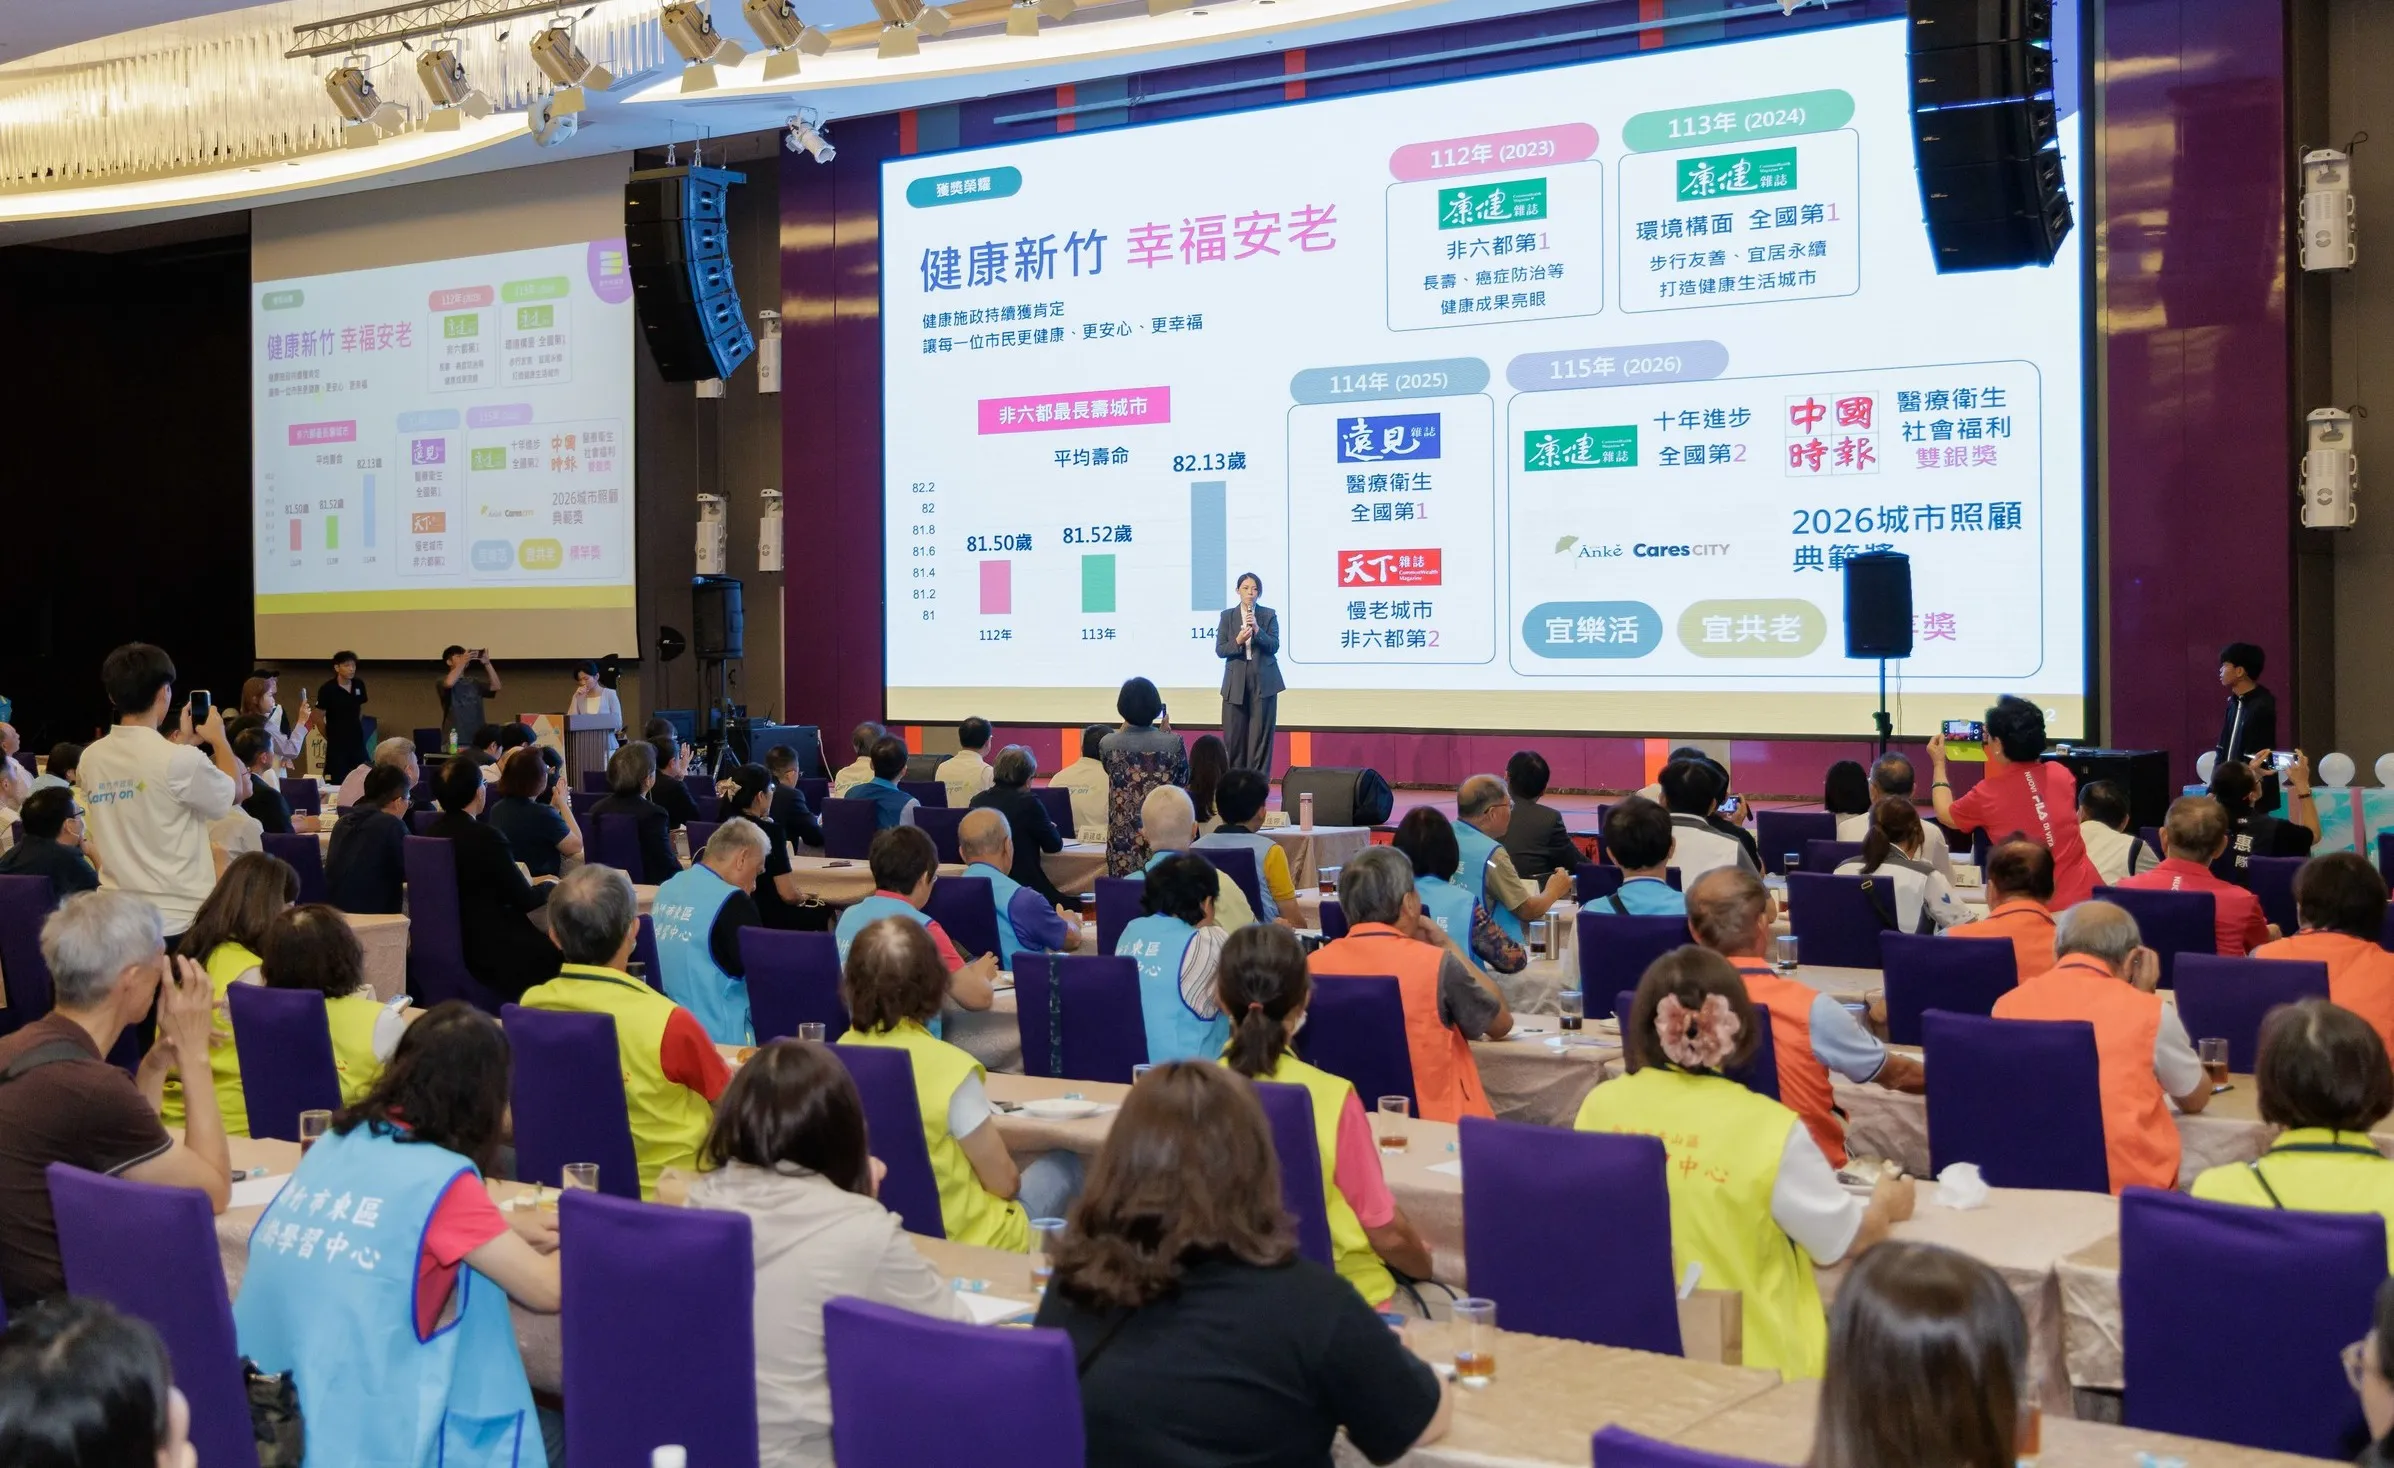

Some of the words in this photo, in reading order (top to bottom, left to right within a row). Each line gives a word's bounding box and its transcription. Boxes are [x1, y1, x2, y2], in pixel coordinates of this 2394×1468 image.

[1667, 111, 1738, 139] 113年
[1744, 107, 1806, 132] (2024)
[1430, 143, 1493, 170] 112年
[1500, 139, 1555, 163] (2023)
[936, 176, 991, 197] 獲獎榮耀
[1681, 157, 1758, 196] 康健
[1443, 188, 1512, 225] 康健
[1635, 211, 1733, 242] 環境構面
[1748, 201, 1841, 231] 全國第1
[919, 228, 1108, 293] 健康新竹
[1126, 202, 1338, 269] 幸福安老
[1446, 231, 1550, 261] 非六都第1
[1649, 239, 1828, 271] 步行友善、宜居永續
[1423, 263, 1564, 291] 長壽、癌症防治等
[1659, 269, 1816, 298] 打造健康生活城市
[922, 301, 1065, 329] 健康施政持續獲肯定
[1440, 290, 1546, 316] 健康成果亮眼
[267, 327, 335, 361] 健康新竹
[340, 320, 413, 354] 幸福安老
[922, 314, 1203, 354] 讓每一位市民更健康、更安心、更幸福
[1549, 356, 1616, 381] 115年
[1623, 354, 1683, 378] (2026)
[1330, 372, 1389, 394] 114年
[1395, 372, 1448, 392] (2025)
[999, 397, 1148, 424] 非六都最長壽城市
[1897, 386, 2007, 414] 醫療衛生
[1653, 406, 1751, 432] 十年進步
[1789, 396, 1875, 435] 中國
[1901, 414, 2012, 443] 社會福利
[1342, 417, 1421, 462] 遠見
[1410, 426, 1437, 438] 雜誌
[1528, 432, 1601, 468] 康健
[1054, 446, 1129, 467] 平均壽命
[1172, 452, 1247, 472] 82.13歲
[1658, 444, 1747, 468] 全國第2
[1789, 437, 1877, 473] 時報
[1915, 445, 1998, 470] 雙銀獎
[912, 482, 935, 494] 82.2
[1346, 472, 1433, 494] 醫療衛生
[921, 503, 935, 514] 82
[1350, 502, 1429, 523] 全國第1
[1792, 501, 2022, 535] 2026城市照顧
[912, 525, 936, 536] 81.8
[966, 533, 1033, 553] 81.50歲
[1062, 524, 1133, 544] 81.52歲
[912, 546, 936, 557] 81.6
[912, 567, 936, 578] 81.4
[1343, 554, 1398, 584] 天下
[1398, 555, 1425, 568] 雜誌
[912, 588, 936, 600] 81.2
[922, 610, 935, 621] 81
[1346, 599, 1433, 621] 慢老城市
[979, 629, 1012, 641] 112年
[1081, 628, 1116, 641] 113年
[1191, 627, 1217, 640] 114
[1341, 628, 1440, 649] 非六都第2
[1545, 616, 1639, 645] 宜樂活
[1702, 615, 1802, 643] 宜共老
[1912, 612, 1956, 641] 獎
[2024, 771, 2037, 793] NUOVI
[86, 790, 116, 805] Carry
[119, 789, 133, 800] on
